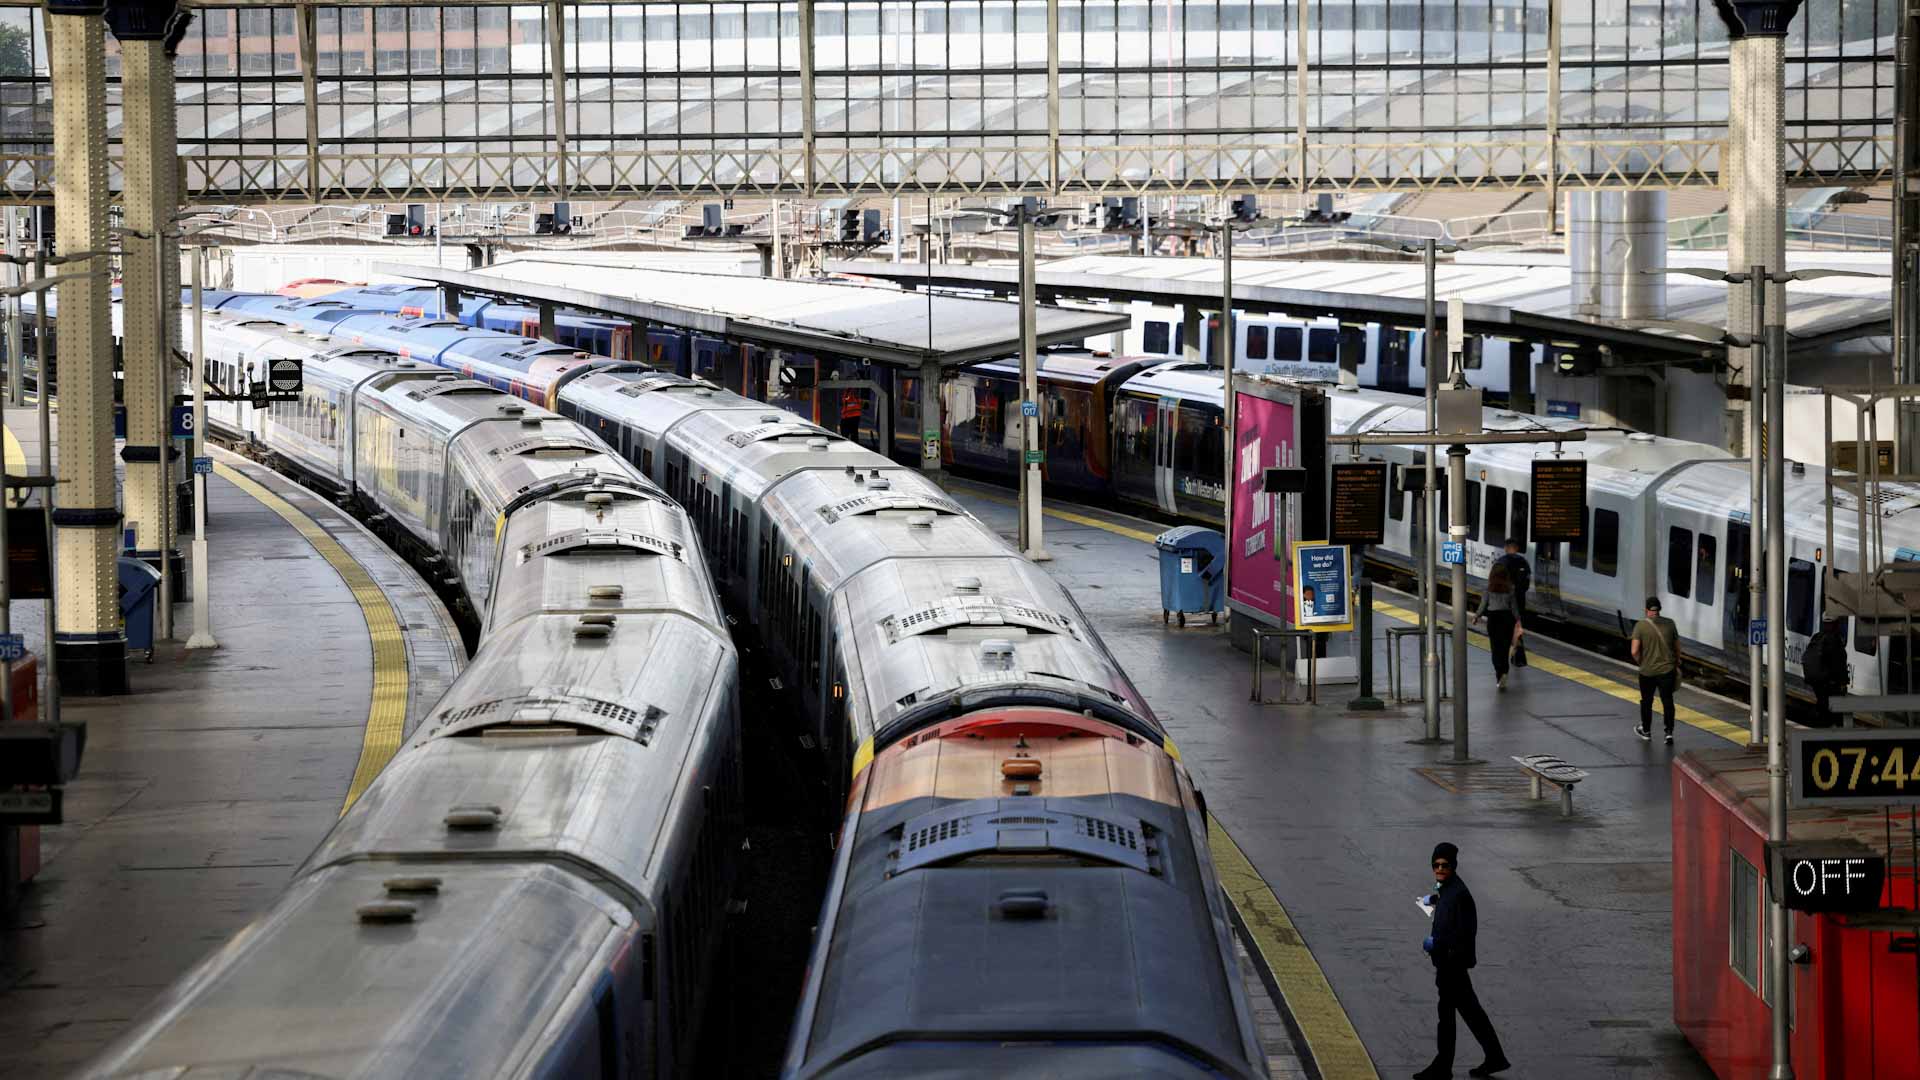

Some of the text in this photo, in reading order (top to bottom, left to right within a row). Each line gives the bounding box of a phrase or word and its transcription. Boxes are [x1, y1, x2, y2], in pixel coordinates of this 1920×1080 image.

[1023, 407, 1037, 416] 017
[182, 412, 194, 430] 8
[195, 463, 212, 473] 015
[1444, 550, 1460, 562] 017
[1793, 859, 1866, 895] OFF
